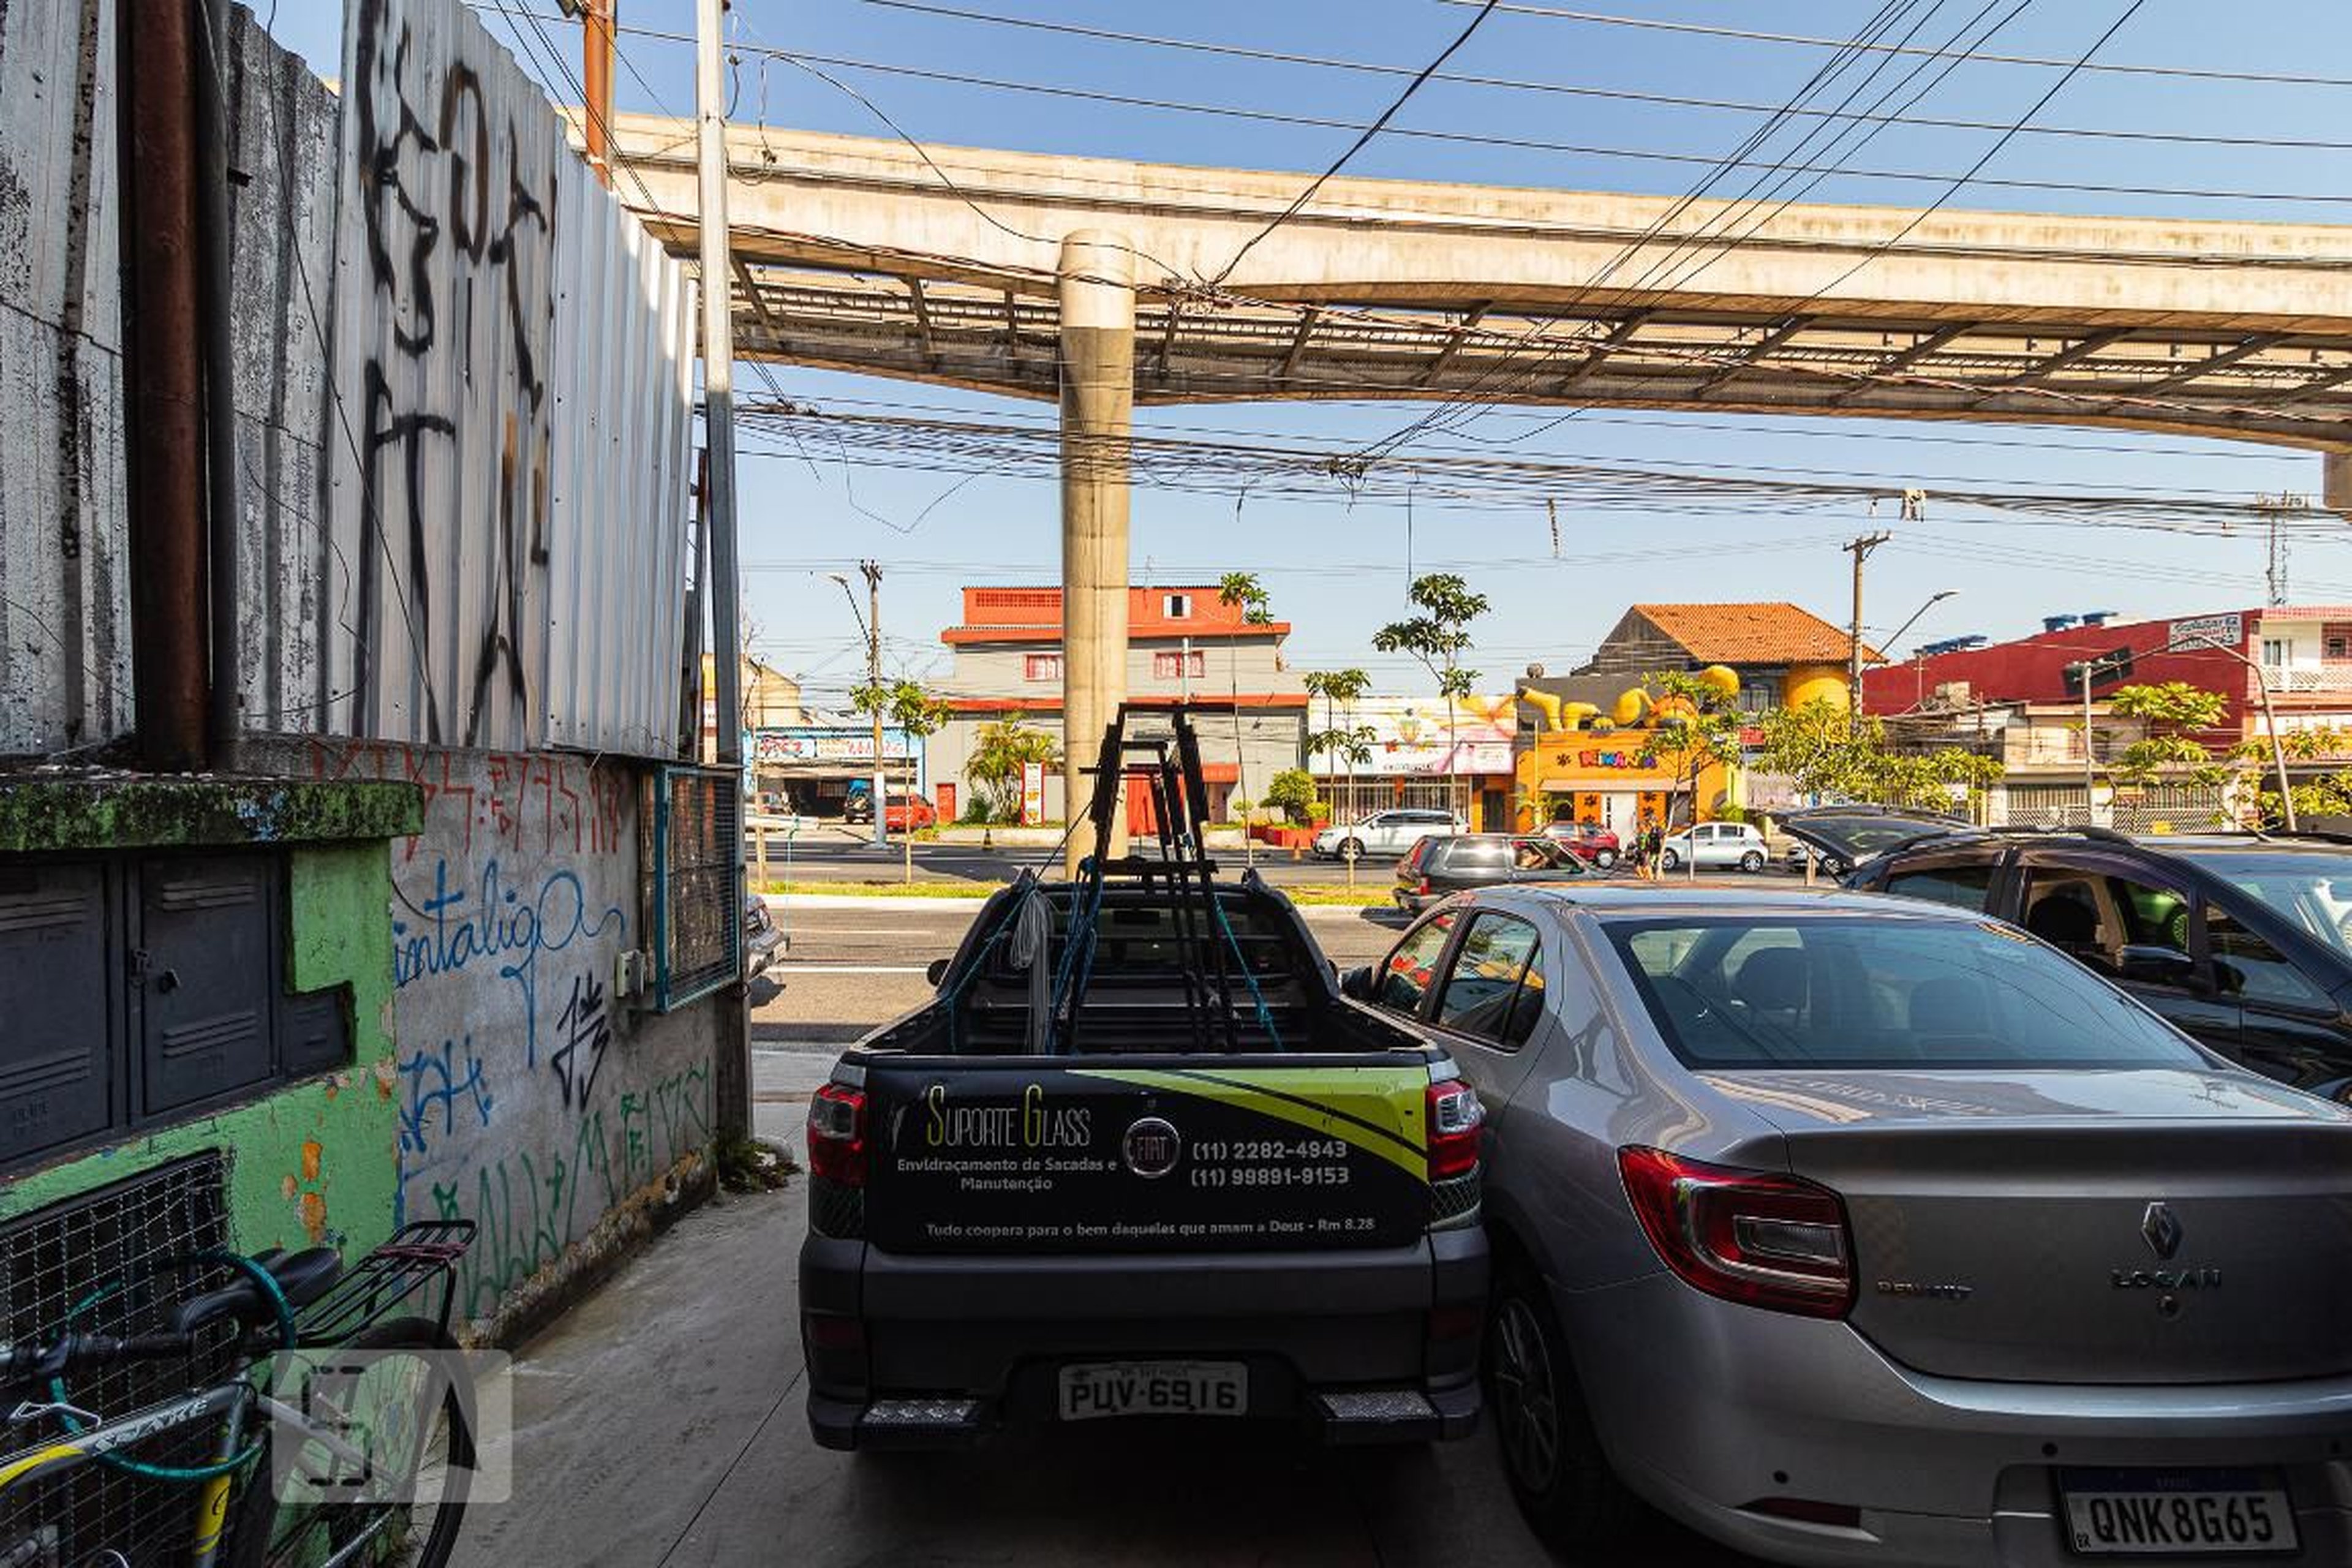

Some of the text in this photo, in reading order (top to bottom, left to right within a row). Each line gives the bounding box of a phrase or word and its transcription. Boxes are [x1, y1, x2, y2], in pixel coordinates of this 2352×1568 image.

[1024, 1084, 1091, 1147] GLASS
[1137, 1136, 1168, 1161] FIAT
[1193, 1142, 1226, 1160] (11)
[897, 1157, 1117, 1175] Envidraçamento de Sacadas e
[961, 1177, 1052, 1192] Manutenção
[1191, 1169, 1226, 1187] (11)
[926, 1224, 962, 1237] Tudo
[966, 1226, 1024, 1238] coopera
[1027, 1226, 1059, 1238] para
[1063, 1226, 1072, 1236] o
[1077, 1223, 1107, 1235] bem
[1112, 1222, 1175, 1238] daqueles
[1179, 1224, 1205, 1236] que
[1210, 1223, 1253, 1234] amam
[1257, 1223, 1265, 1233] a
[1269, 1219, 1305, 1233] Deus
[1317, 1218, 1341, 1232] Rm
[1345, 1217, 1376, 1231] 8.28
[2089, 1496, 2274, 1544] QNK8G65
